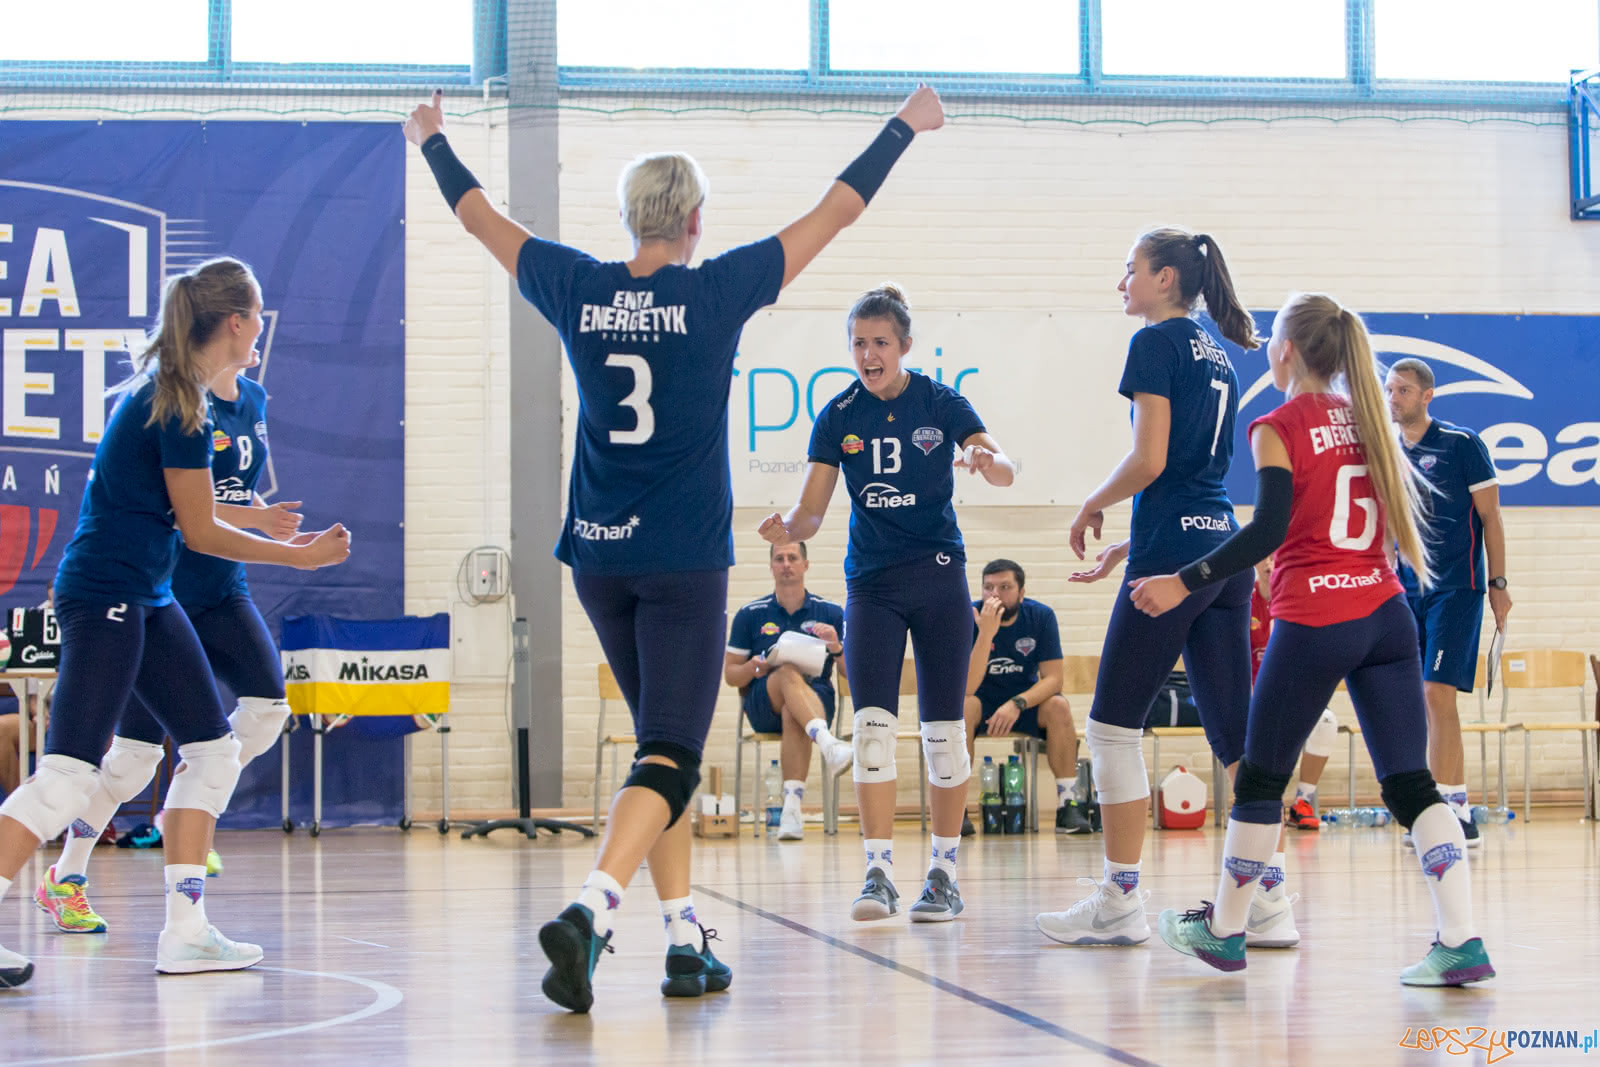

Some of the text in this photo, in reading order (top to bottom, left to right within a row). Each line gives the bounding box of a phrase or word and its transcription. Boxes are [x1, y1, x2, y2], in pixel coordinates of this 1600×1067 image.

[579, 303, 687, 335] ENERGETYK
[604, 353, 655, 445] 3
[1210, 378, 1229, 456] 7
[1327, 407, 1356, 424] ENE
[237, 435, 252, 471] 8
[870, 437, 902, 475] 13
[864, 492, 917, 508] Enea
[1329, 464, 1378, 551] 6
[106, 603, 128, 622] 2
